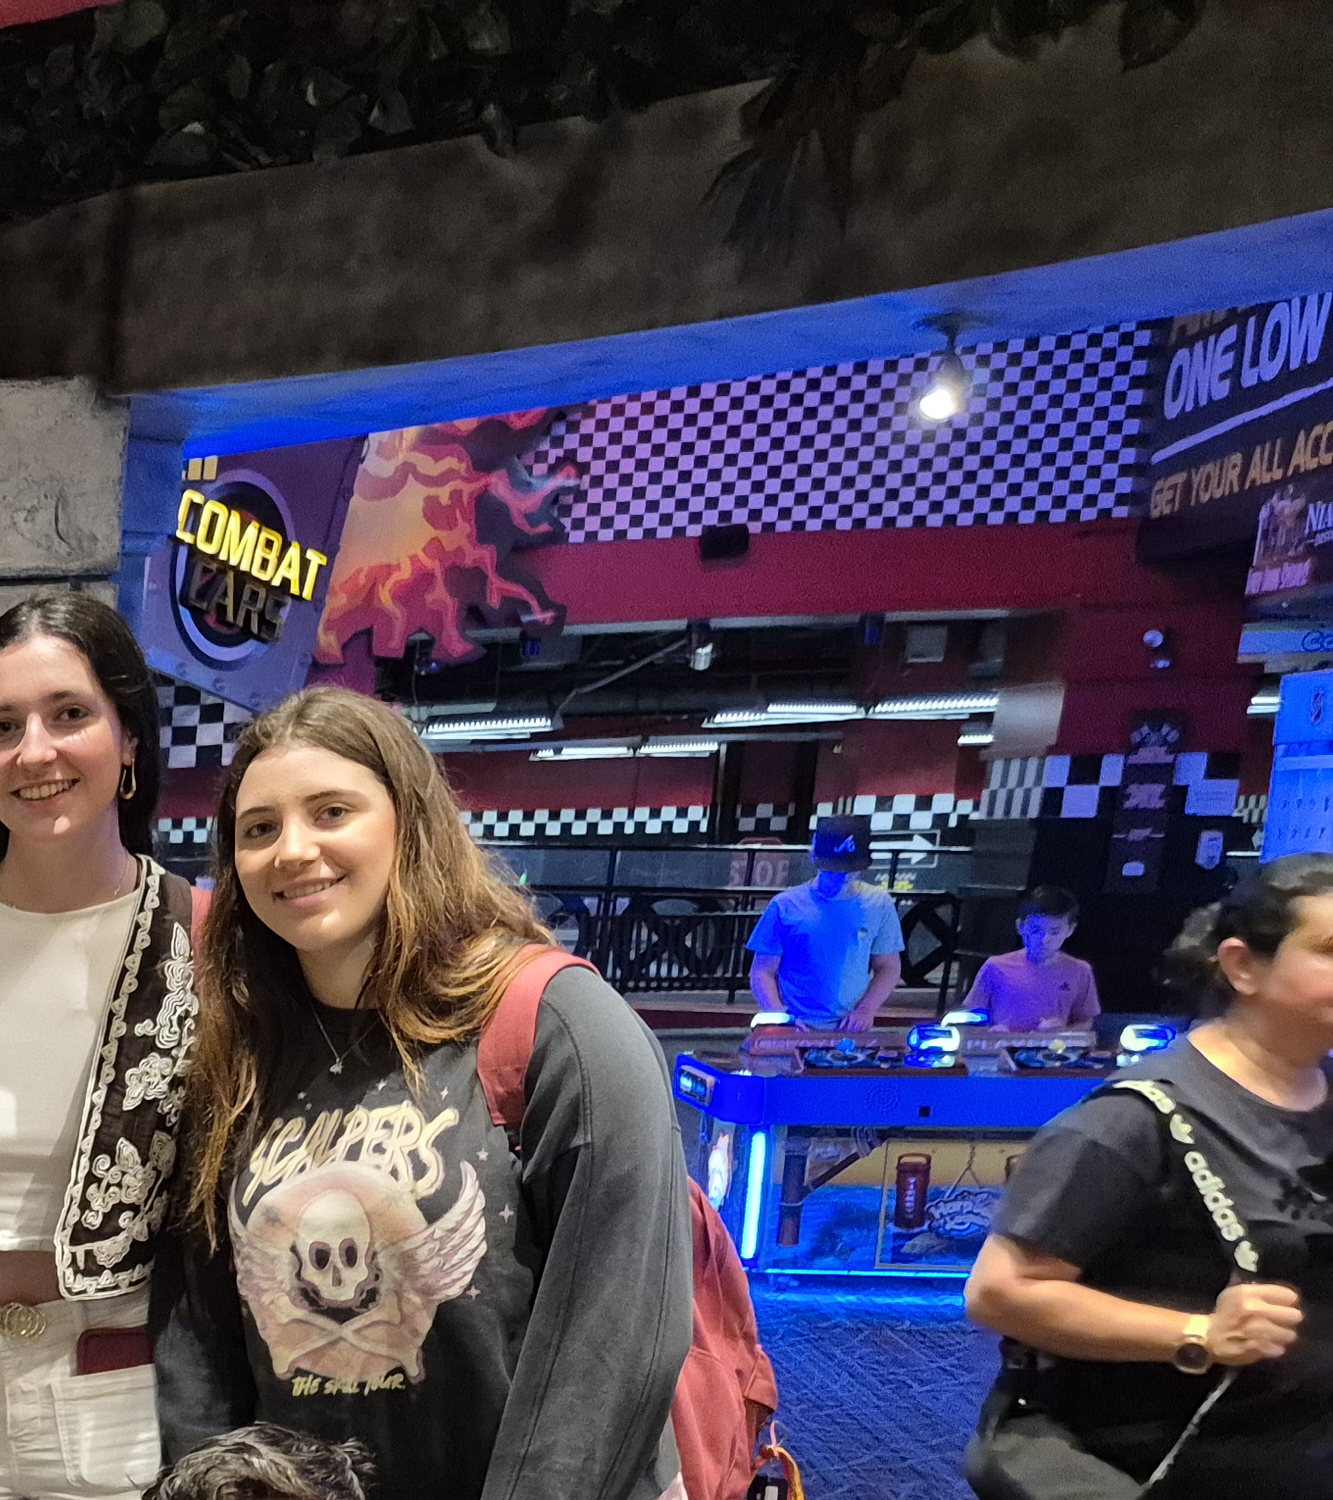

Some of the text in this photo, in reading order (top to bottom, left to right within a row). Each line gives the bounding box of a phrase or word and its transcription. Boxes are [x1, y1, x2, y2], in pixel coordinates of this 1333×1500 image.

[1164, 291, 1332, 420] ONE LOW
[1150, 472, 1187, 519] GET
[1190, 452, 1243, 506] YOUR
[1244, 437, 1283, 490] ALL
[176, 489, 328, 602] COMBAT
[241, 1099, 460, 1207] SCALPERS
[1184, 1151, 1246, 1241] adidas
